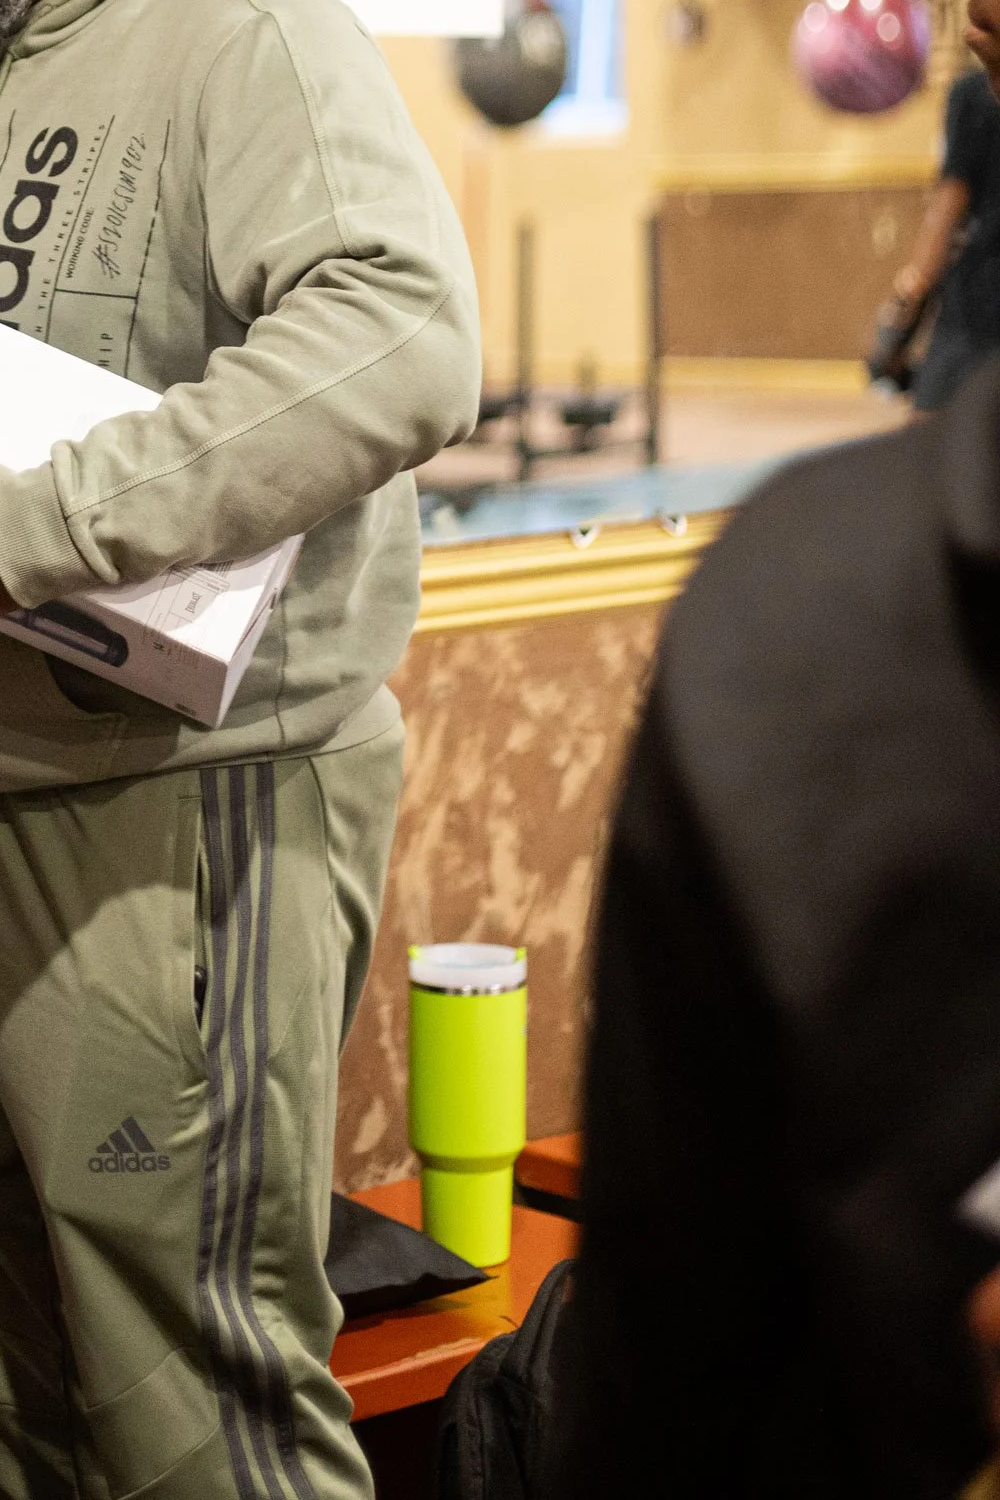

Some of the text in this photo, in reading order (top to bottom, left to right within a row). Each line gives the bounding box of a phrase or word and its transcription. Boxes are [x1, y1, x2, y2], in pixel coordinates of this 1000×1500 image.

[48, 209, 74, 263] THREE
[74, 124, 106, 197] STRIPES
[65, 235, 85, 279] WORKING
[88, 1152, 171, 1173] adidas
